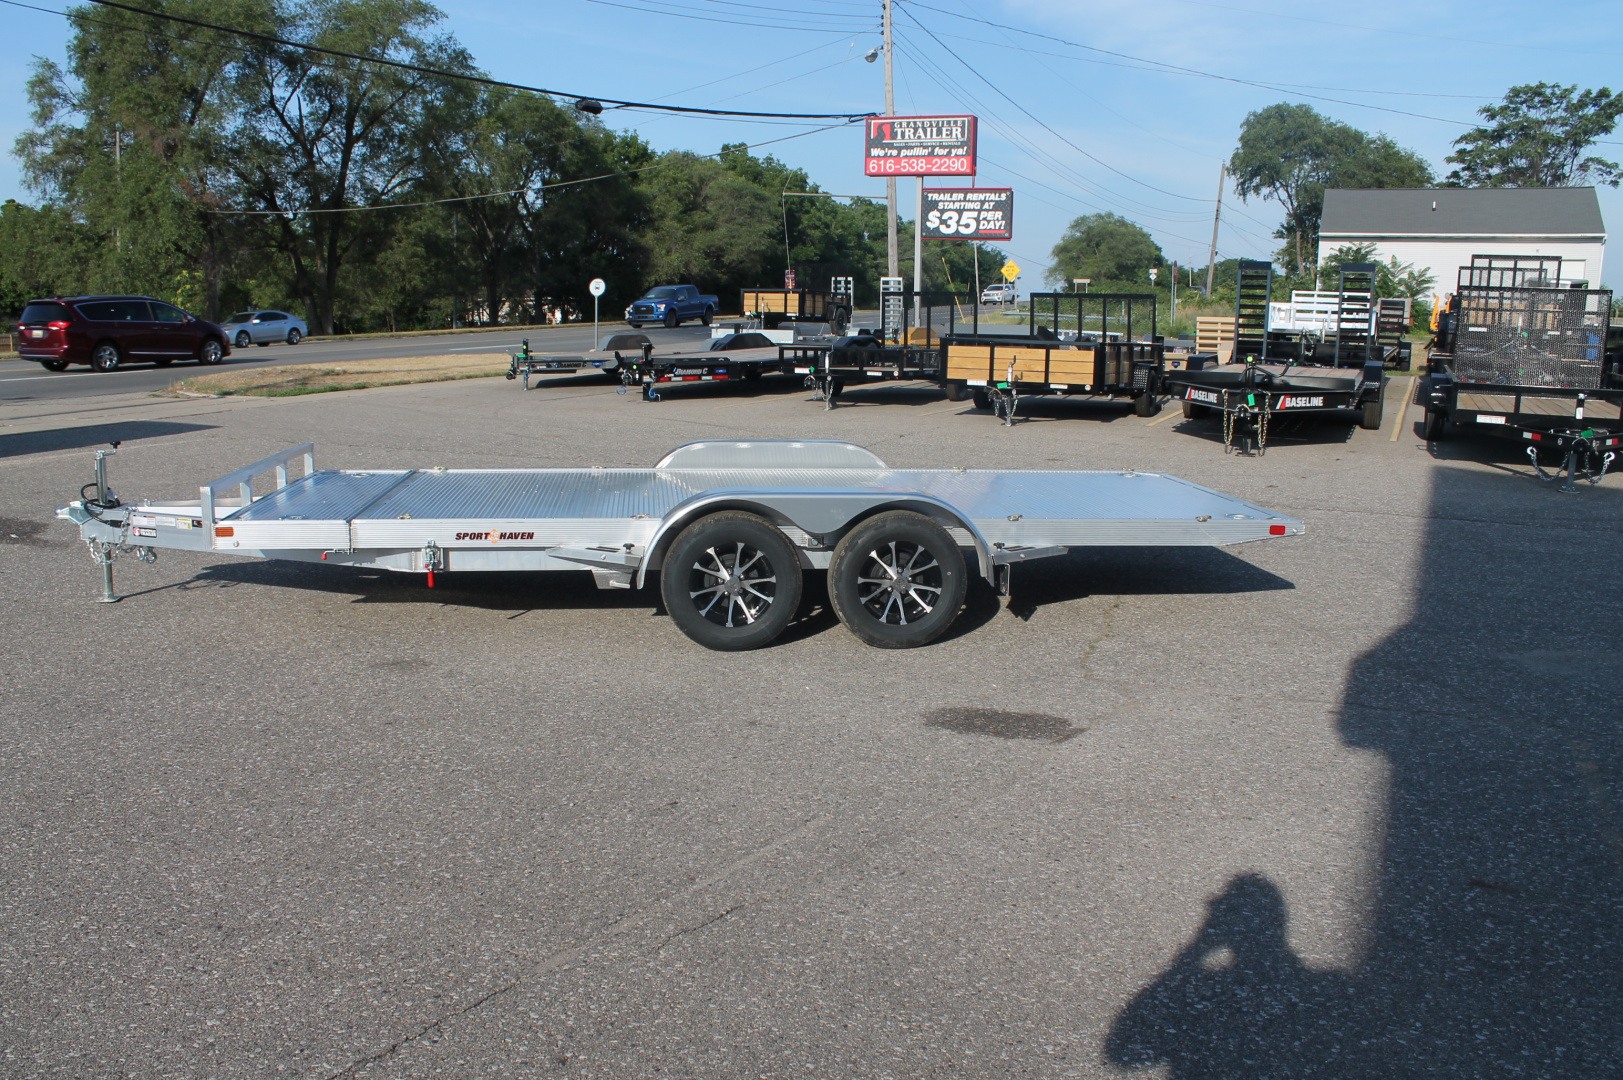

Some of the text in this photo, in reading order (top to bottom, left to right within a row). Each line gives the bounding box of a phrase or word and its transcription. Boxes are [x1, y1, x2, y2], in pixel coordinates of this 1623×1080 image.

[894, 120, 963, 128] GRANDVILLE
[894, 127, 962, 140] TRAILER
[870, 146, 967, 157] We're pullin' for ya!
[869, 158, 967, 172] 616-538-2290
[927, 192, 1007, 201] TRAILER RENTALS
[938, 201, 995, 210] STARTING AT
[979, 211, 1003, 220] PER
[926, 209, 979, 235] $35
[979, 220, 1006, 230] DAY!
[702, 367, 708, 375] C
[1190, 389, 1218, 403] BASELINE
[1285, 396, 1324, 407] BASELINE
[455, 532, 535, 540] SPORT HAVEN
